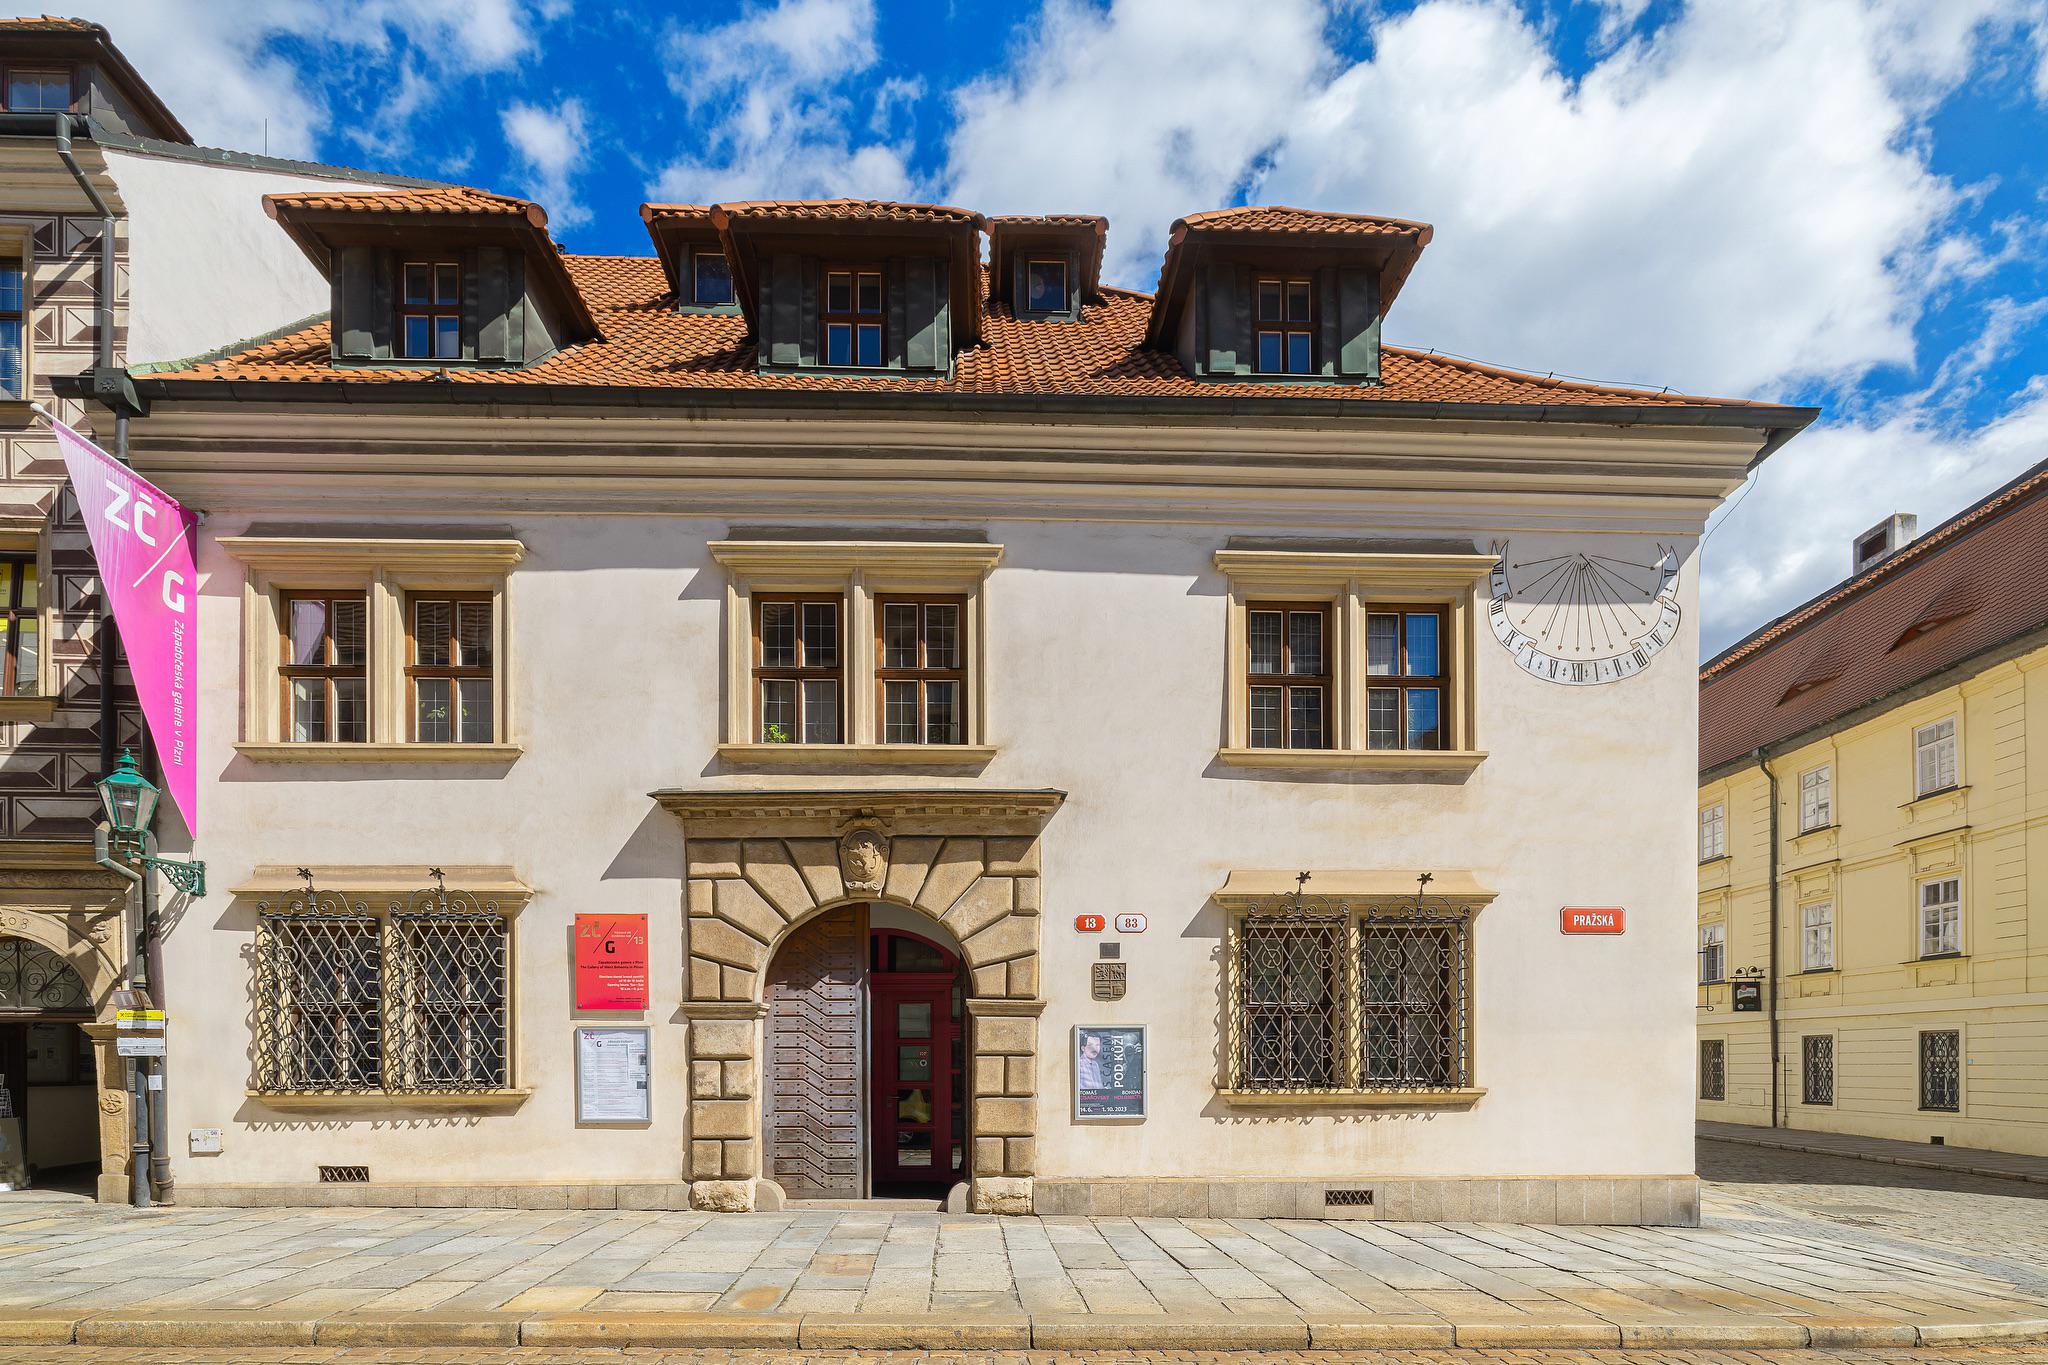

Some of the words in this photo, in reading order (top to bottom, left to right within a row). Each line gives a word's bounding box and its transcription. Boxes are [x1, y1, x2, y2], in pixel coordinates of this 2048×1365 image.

[162, 569, 185, 614] G
[173, 619, 185, 689] Západočeská
[1503, 629, 1519, 647] IX
[1523, 650, 1537, 669] X
[1545, 658, 1558, 679] XI
[1569, 662, 1583, 682] XII
[1613, 658, 1624, 677] II
[1632, 649, 1648, 668] III
[171, 690, 185, 727] galerie
[1084, 917, 1097, 929] 13
[1124, 917, 1138, 929] 83
[1573, 911, 1615, 926] PRAŽSKÁ
[605, 940, 616, 954] G
[633, 936, 644, 945] 13
[1114, 1063, 1124, 1088] POD
